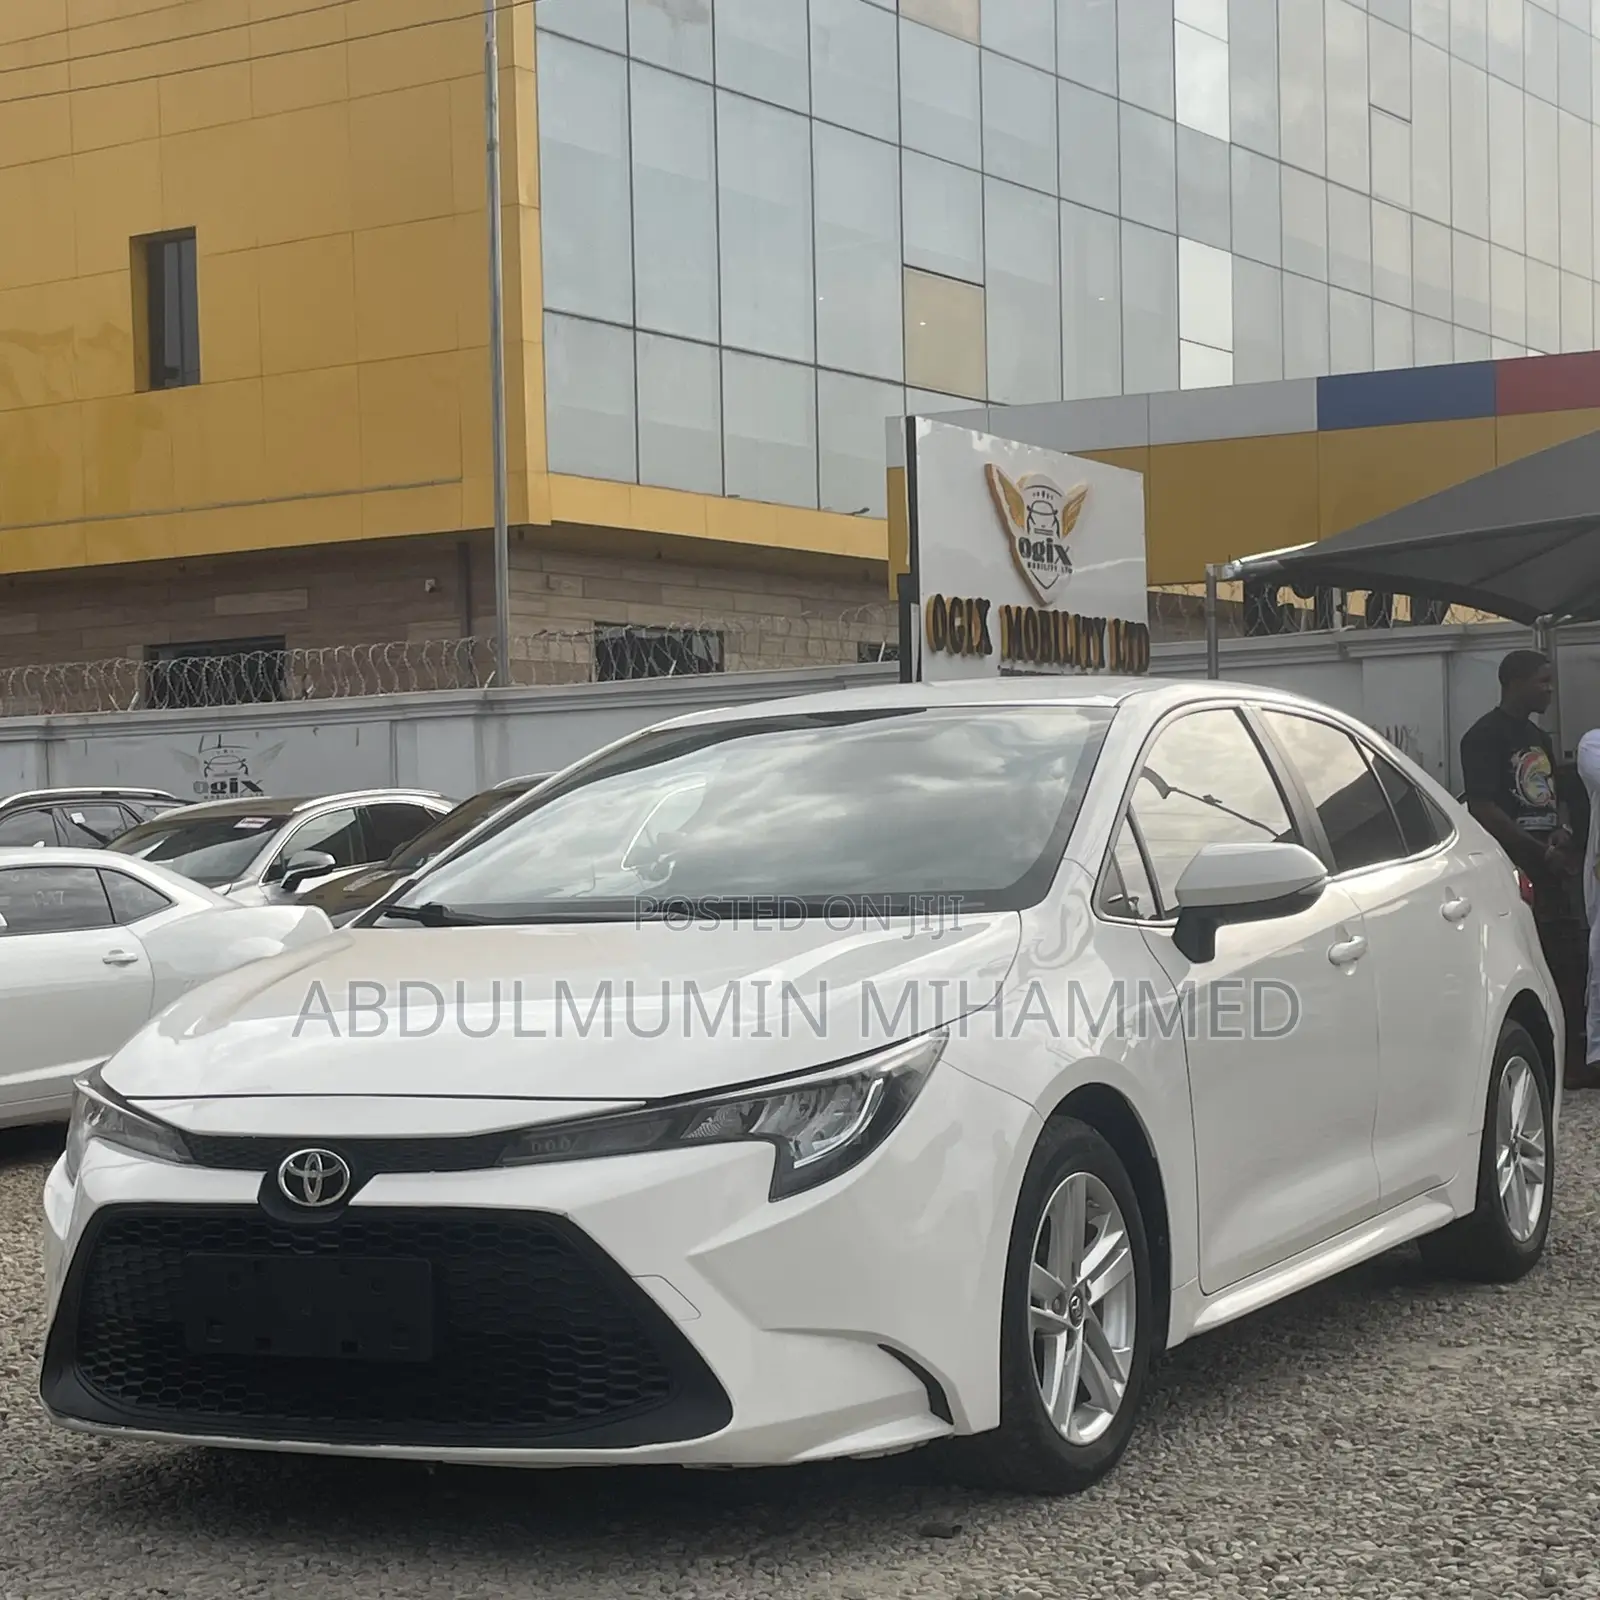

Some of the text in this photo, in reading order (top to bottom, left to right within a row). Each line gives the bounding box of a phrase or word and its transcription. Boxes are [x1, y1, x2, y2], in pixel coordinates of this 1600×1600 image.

[926, 594, 1150, 674] OGIX MOBILITY LTD
